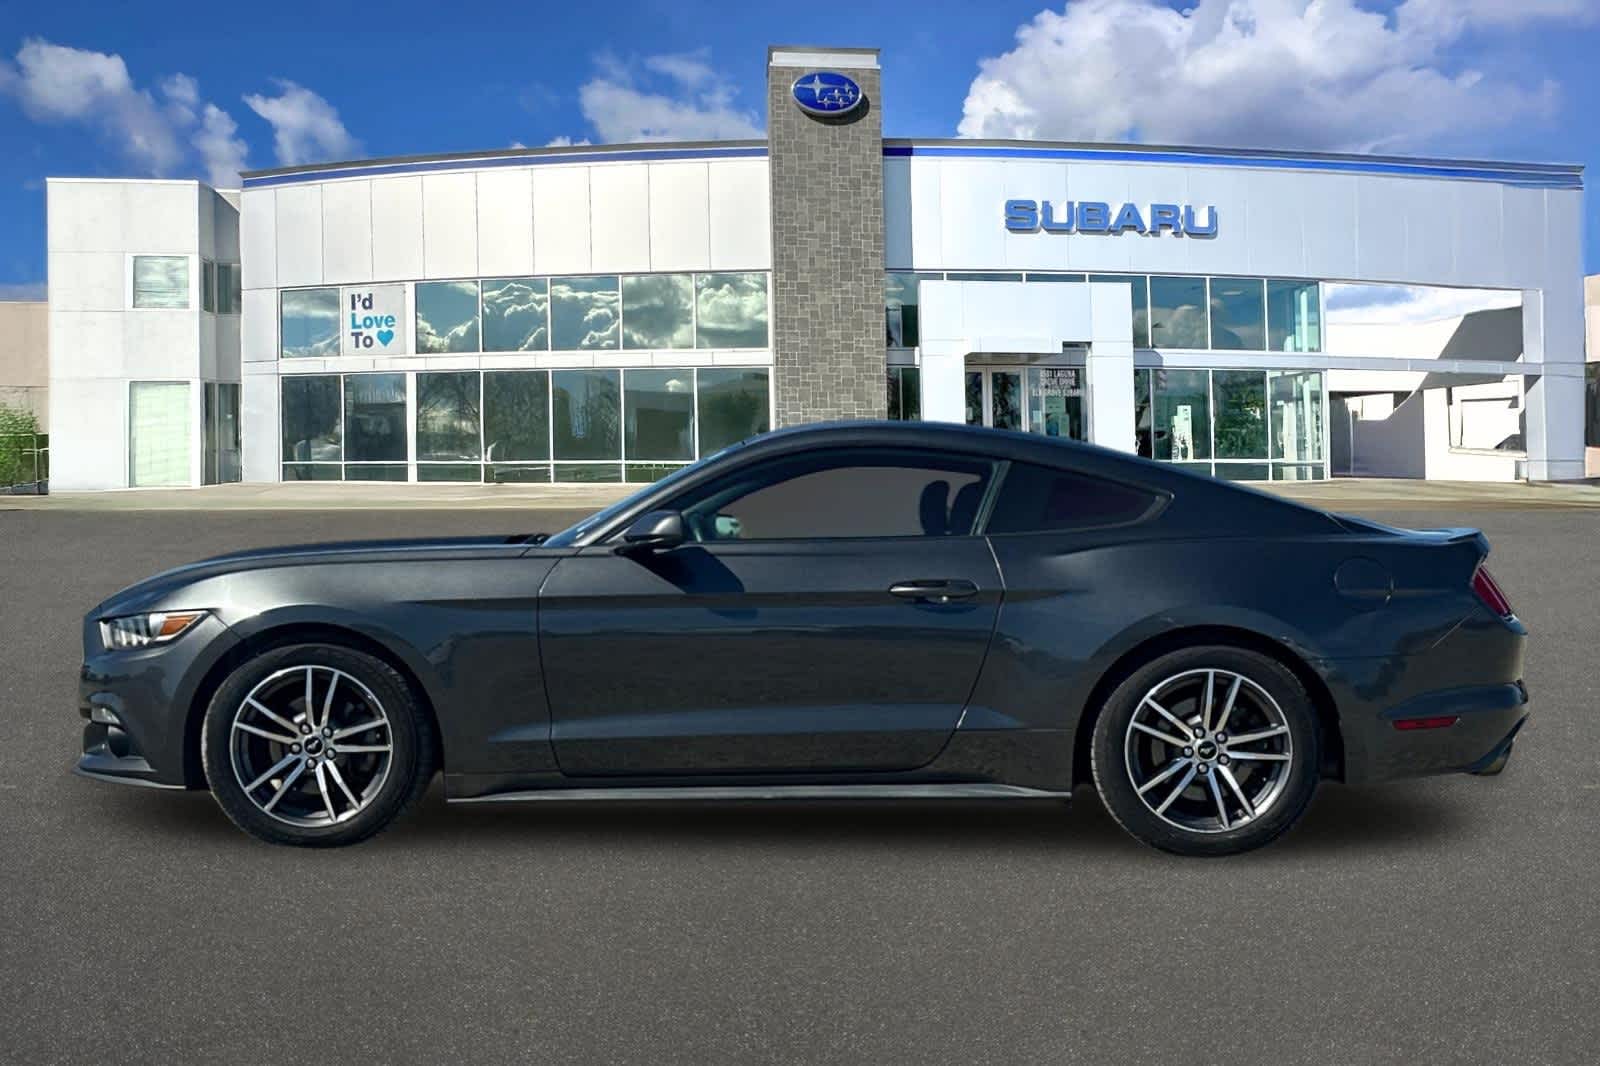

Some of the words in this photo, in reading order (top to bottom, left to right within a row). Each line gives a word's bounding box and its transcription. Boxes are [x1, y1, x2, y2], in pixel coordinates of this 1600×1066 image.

[1005, 199, 1218, 239] SUBARU
[351, 293, 373, 311] I'd
[351, 312, 396, 329] Love
[351, 331, 374, 348] To
